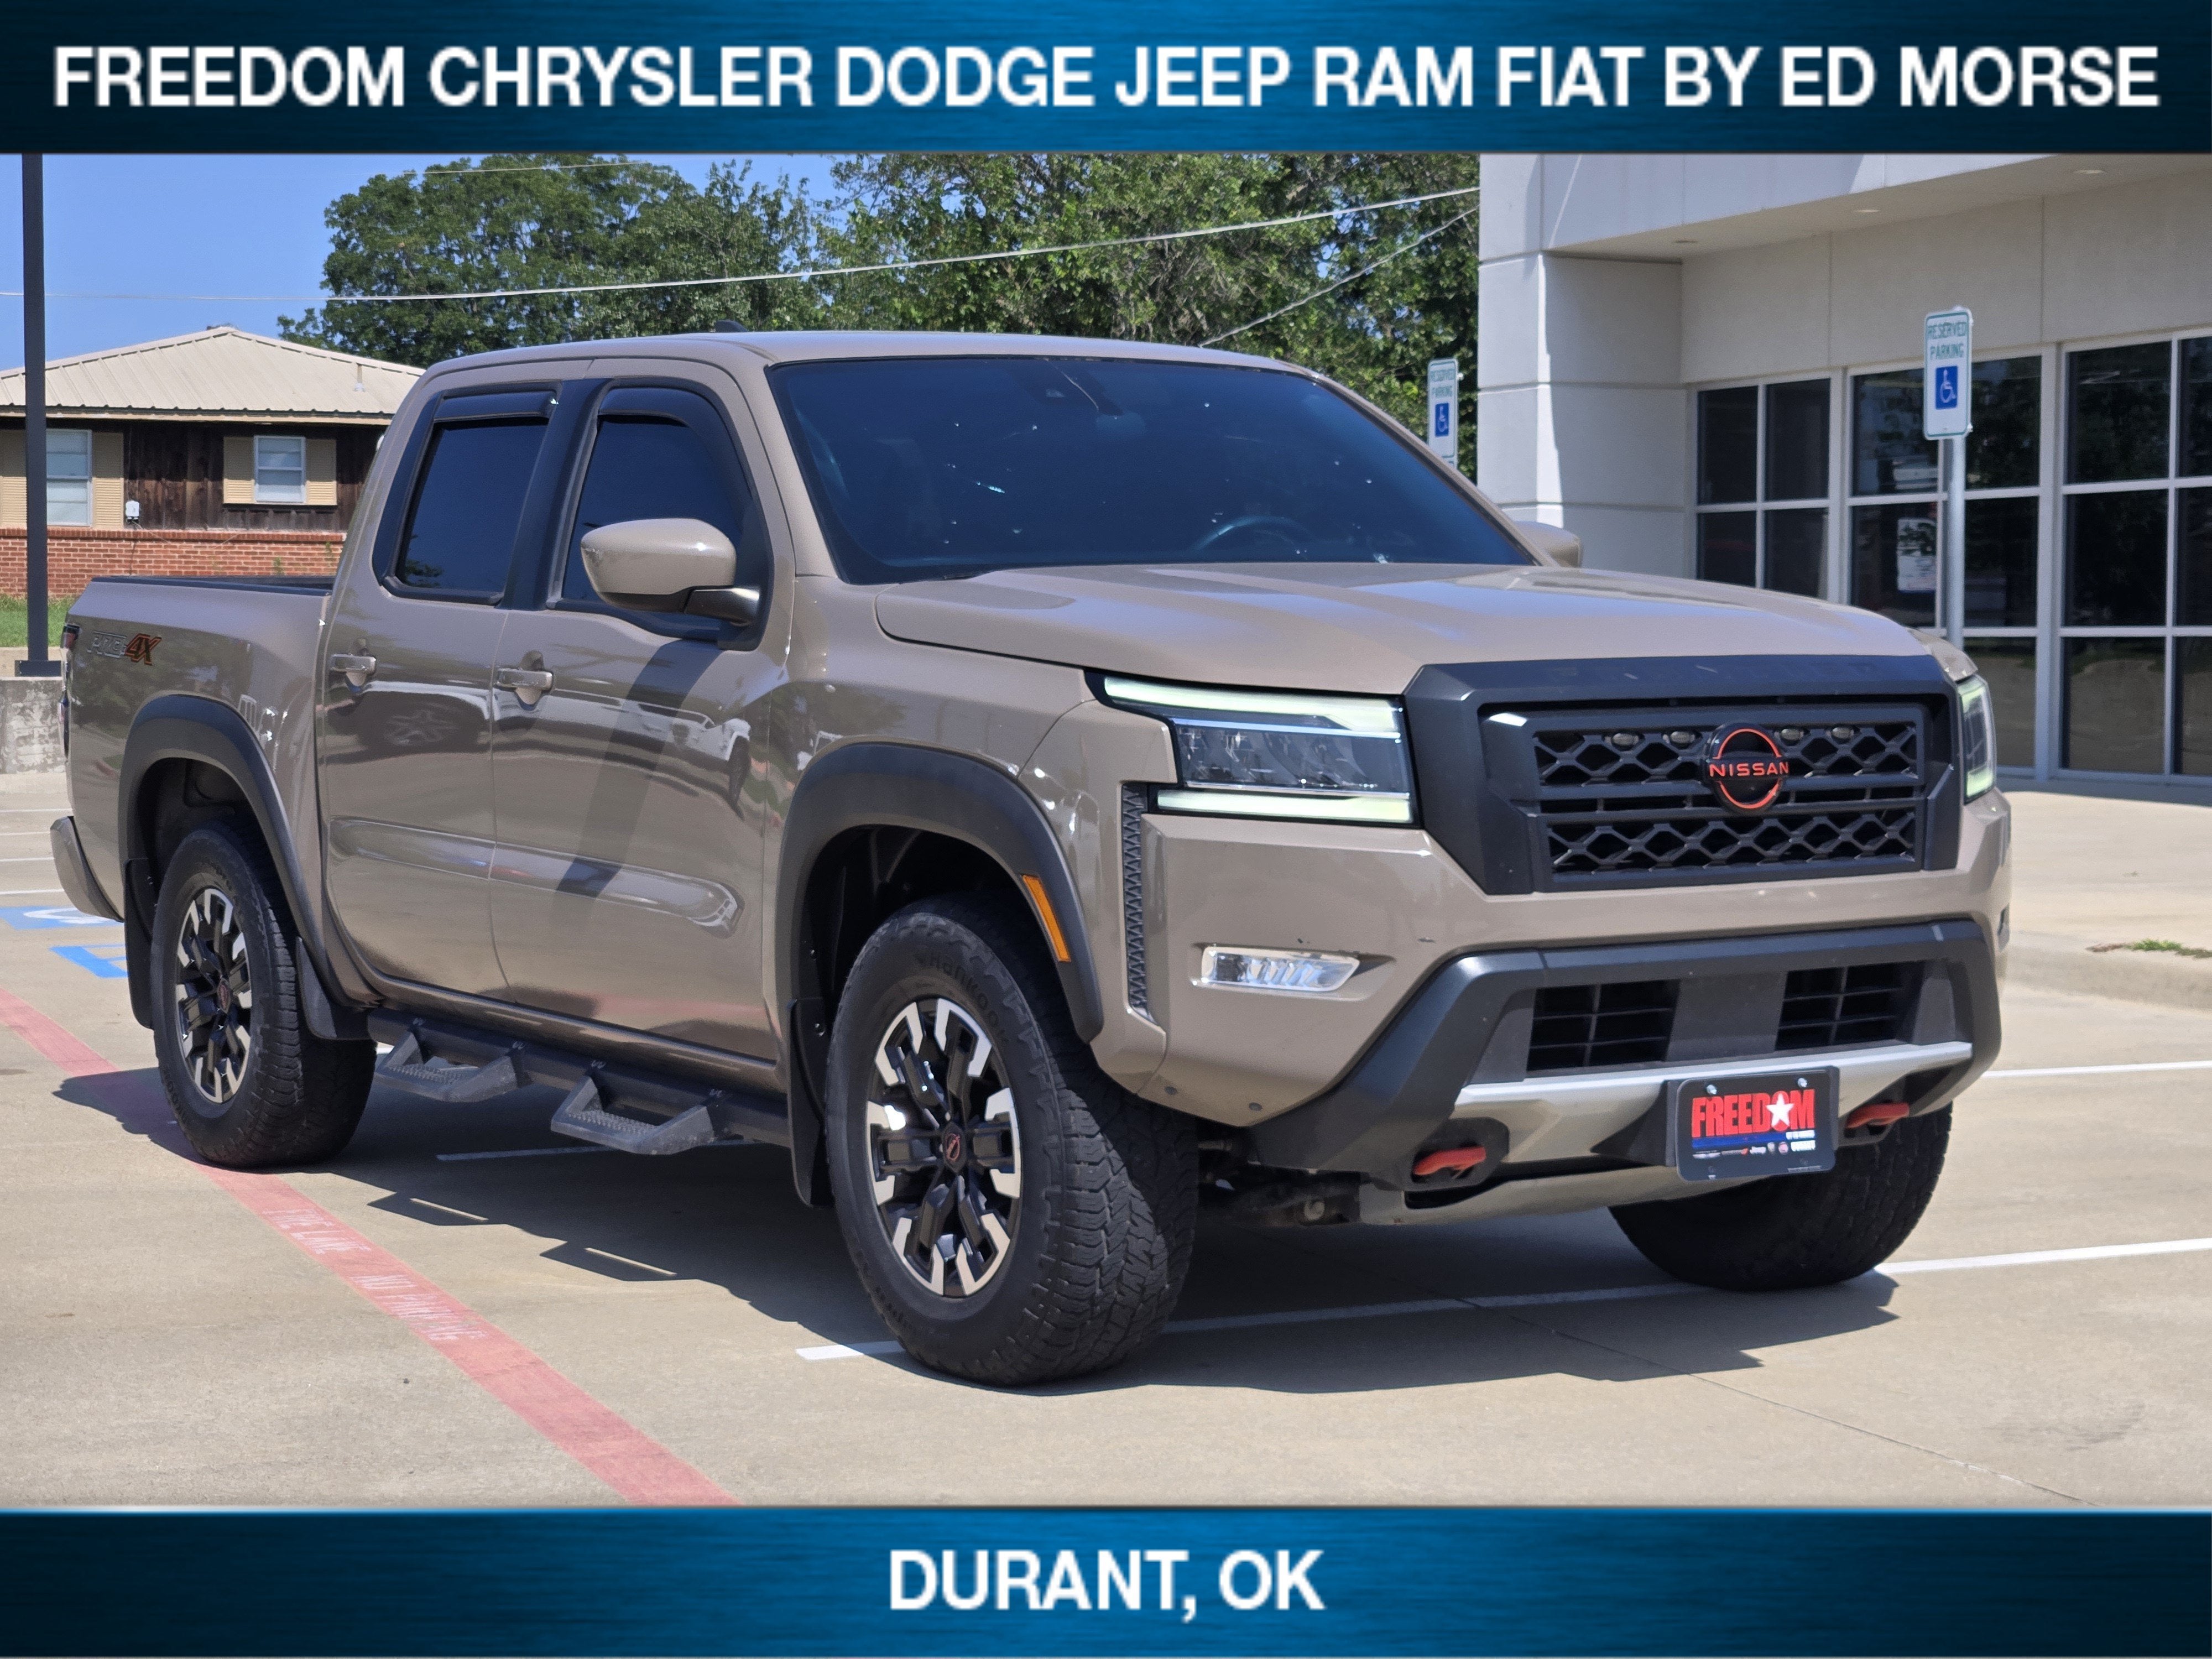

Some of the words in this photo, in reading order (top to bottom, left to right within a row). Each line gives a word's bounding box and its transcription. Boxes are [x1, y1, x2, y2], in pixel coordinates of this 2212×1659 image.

[1928, 322, 1966, 340] RESERVED
[1930, 343, 1964, 358] PARKING
[1709, 761, 1790, 777] NISSAN
[1691, 1088, 1815, 1138] FREEDOM
